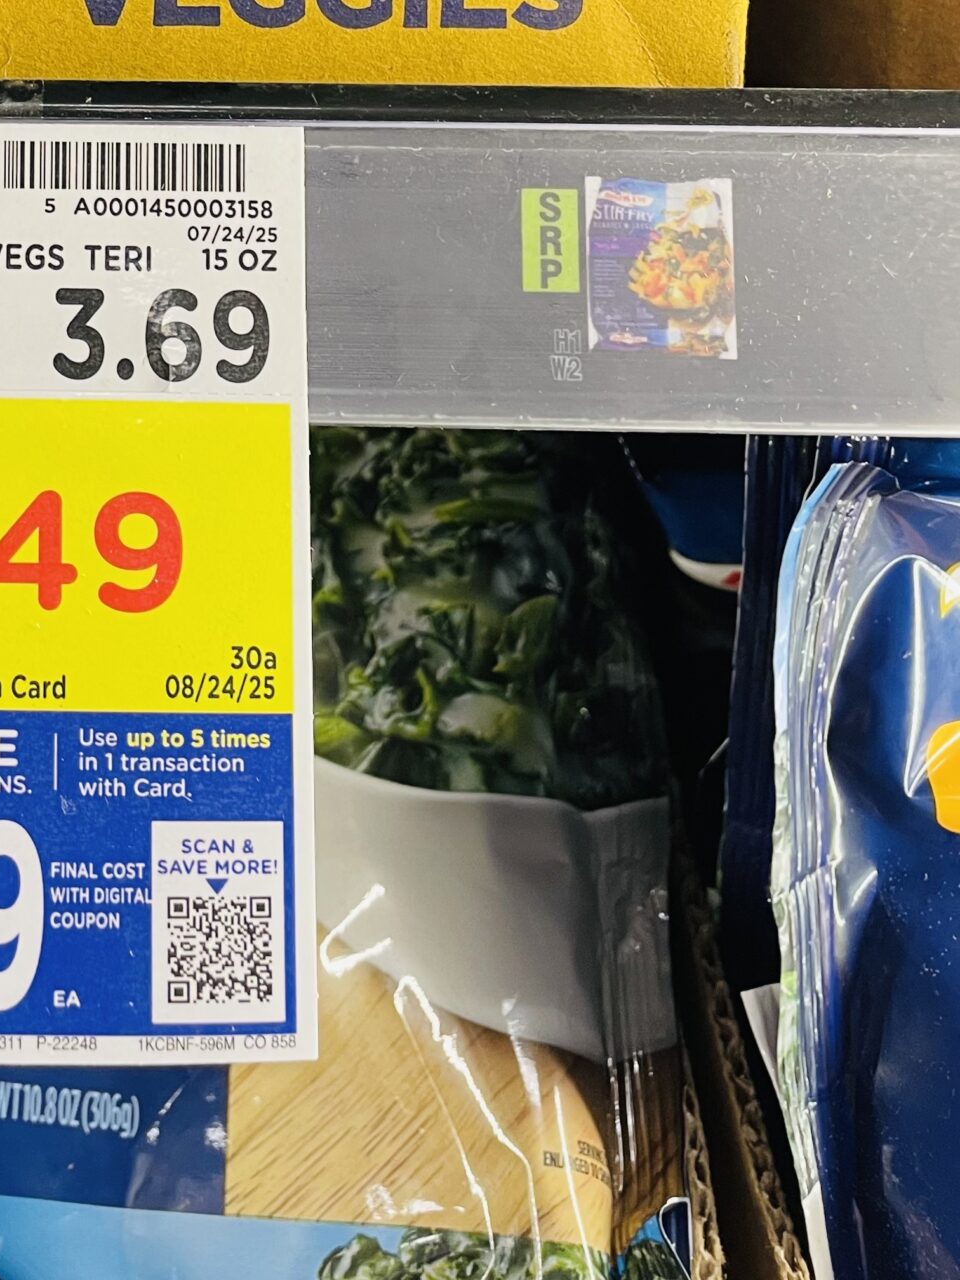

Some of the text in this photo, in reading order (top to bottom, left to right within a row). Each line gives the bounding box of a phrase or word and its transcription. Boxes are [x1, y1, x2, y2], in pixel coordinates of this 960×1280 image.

[44, 197, 274, 220] 5 A0001450003158
[187, 224, 279, 245] 07/24/25
[84, 245, 152, 273] TERI
[202, 248, 228, 272] 15
[237, 250, 279, 273] OZ
[52, 287, 271, 385] 3.69
[229, 646, 278, 670] 30a
[10, 673, 68, 701] Card
[164, 674, 276, 701] 08/24/25
[78, 728, 272, 753] Use up to 5 times
[78, 754, 246, 774] in 1 transaction
[79, 777, 193, 800] with Card.
[181, 837, 256, 855] SCAN &
[50, 861, 146, 880] FINAL COST
[156, 858, 279, 877] SAVE MORE!
[50, 886, 153, 905] WITH DIGITAL
[50, 911, 121, 930] COUPON
[52, 989, 82, 1010] EA
[36, 1036, 98, 1051] P-22248
[243, 1036, 267, 1050] CO
[270, 1035, 297, 1049] 858
